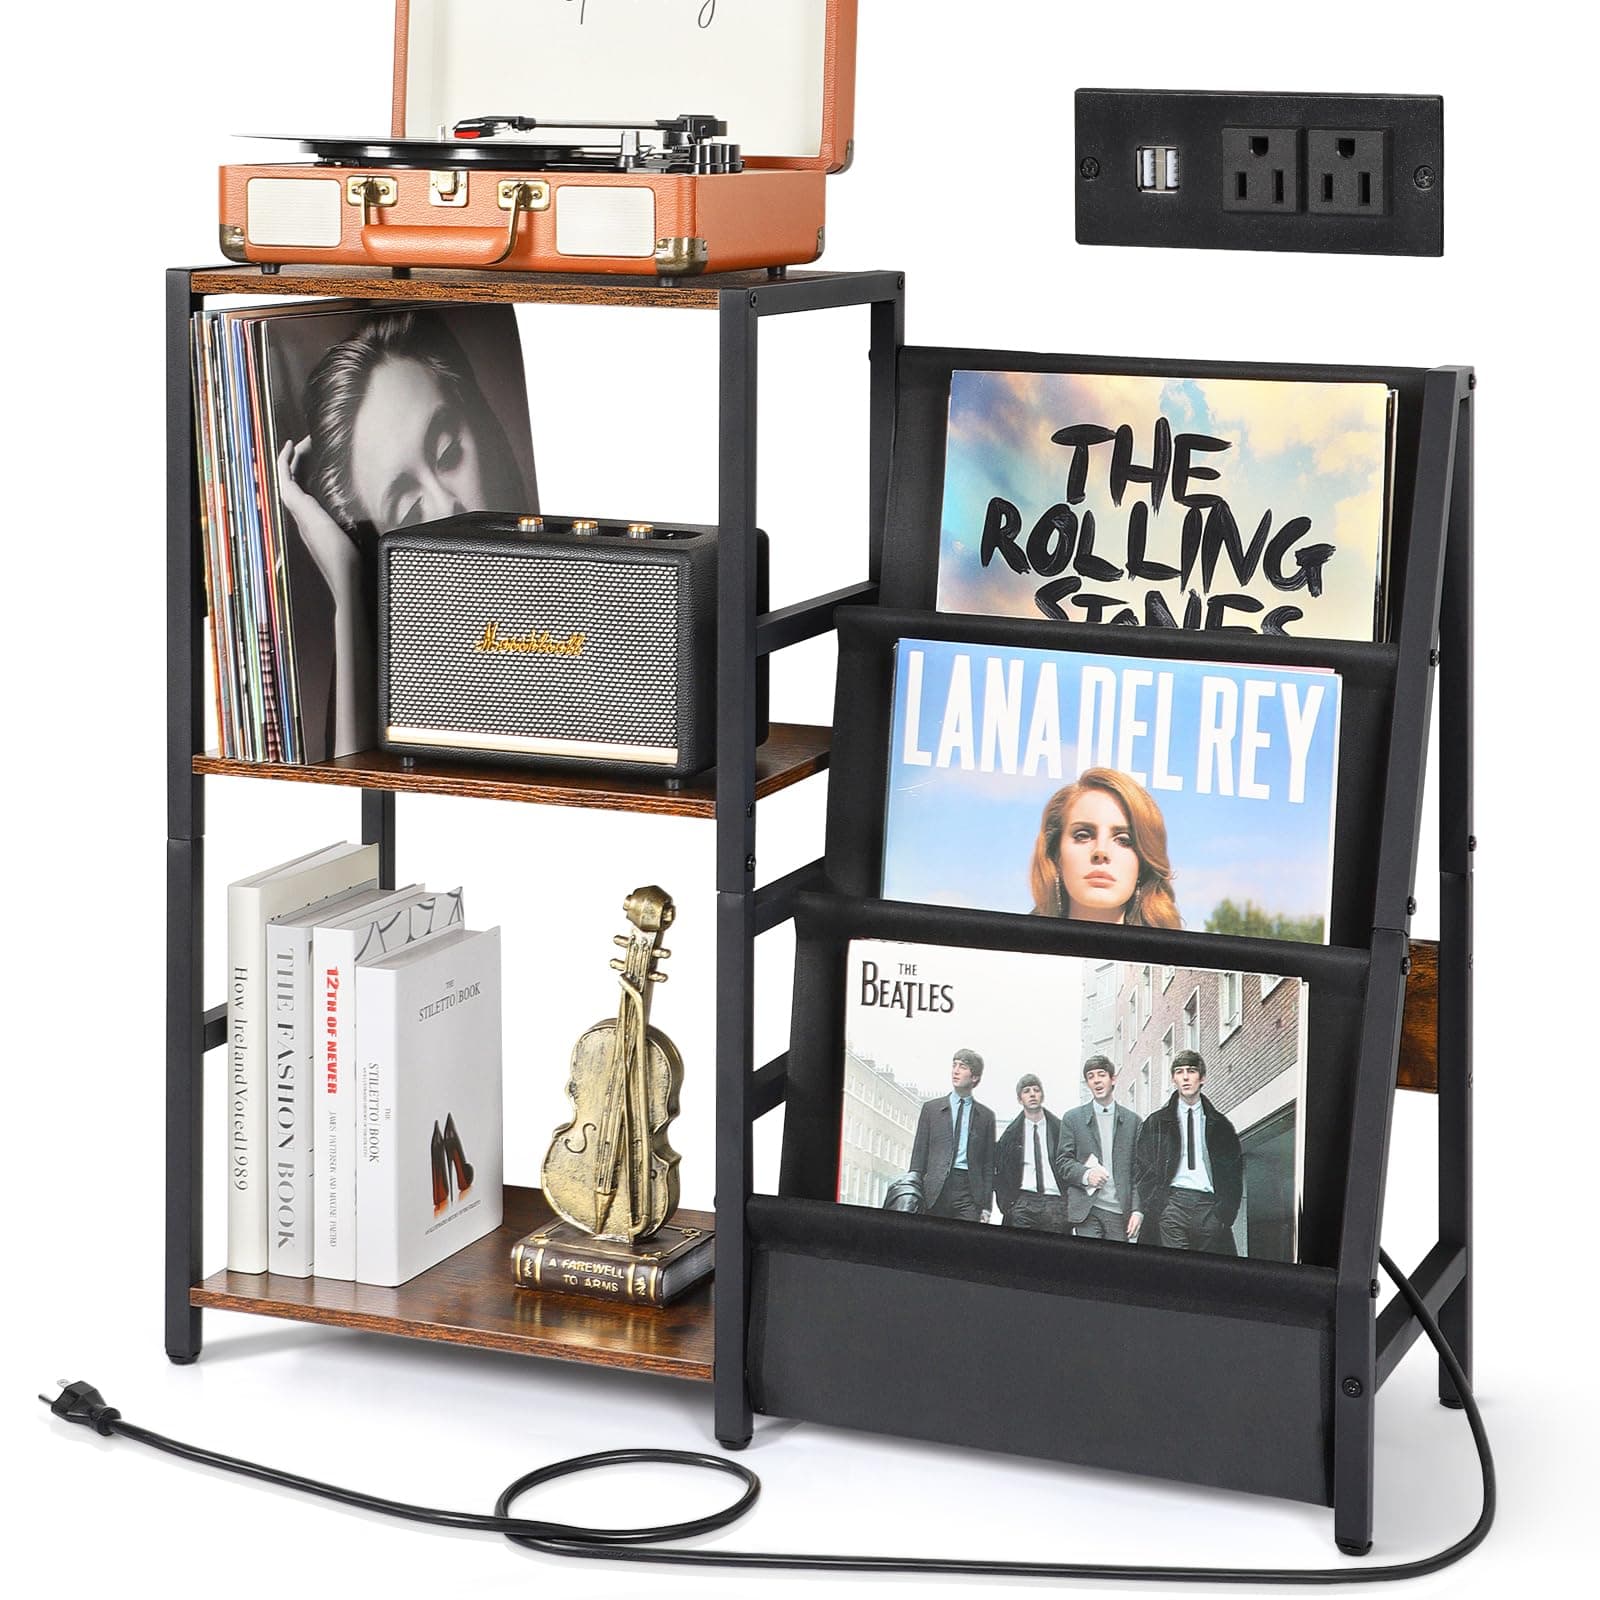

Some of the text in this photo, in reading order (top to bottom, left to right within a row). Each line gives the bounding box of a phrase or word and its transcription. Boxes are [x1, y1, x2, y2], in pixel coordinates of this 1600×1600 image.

[1051, 416, 1232, 516] THE
[981, 497, 1337, 598] ROLLING
[903, 650, 1325, 804] LANA DEL REY
[233, 966, 248, 1010] How
[419, 981, 481, 1022] STILETTO BOOK
[860, 960, 955, 1018] BEATLES
[898, 963, 918, 976] THE
[326, 966, 340, 1095] 12TH OF NEVER
[276, 949, 296, 1249] THE FASHION BOOK
[368, 1062, 380, 1162] STILETTO BOOK
[548, 1258, 625, 1279] A FAREWELL
[563, 1274, 618, 1292] TO ARMS
